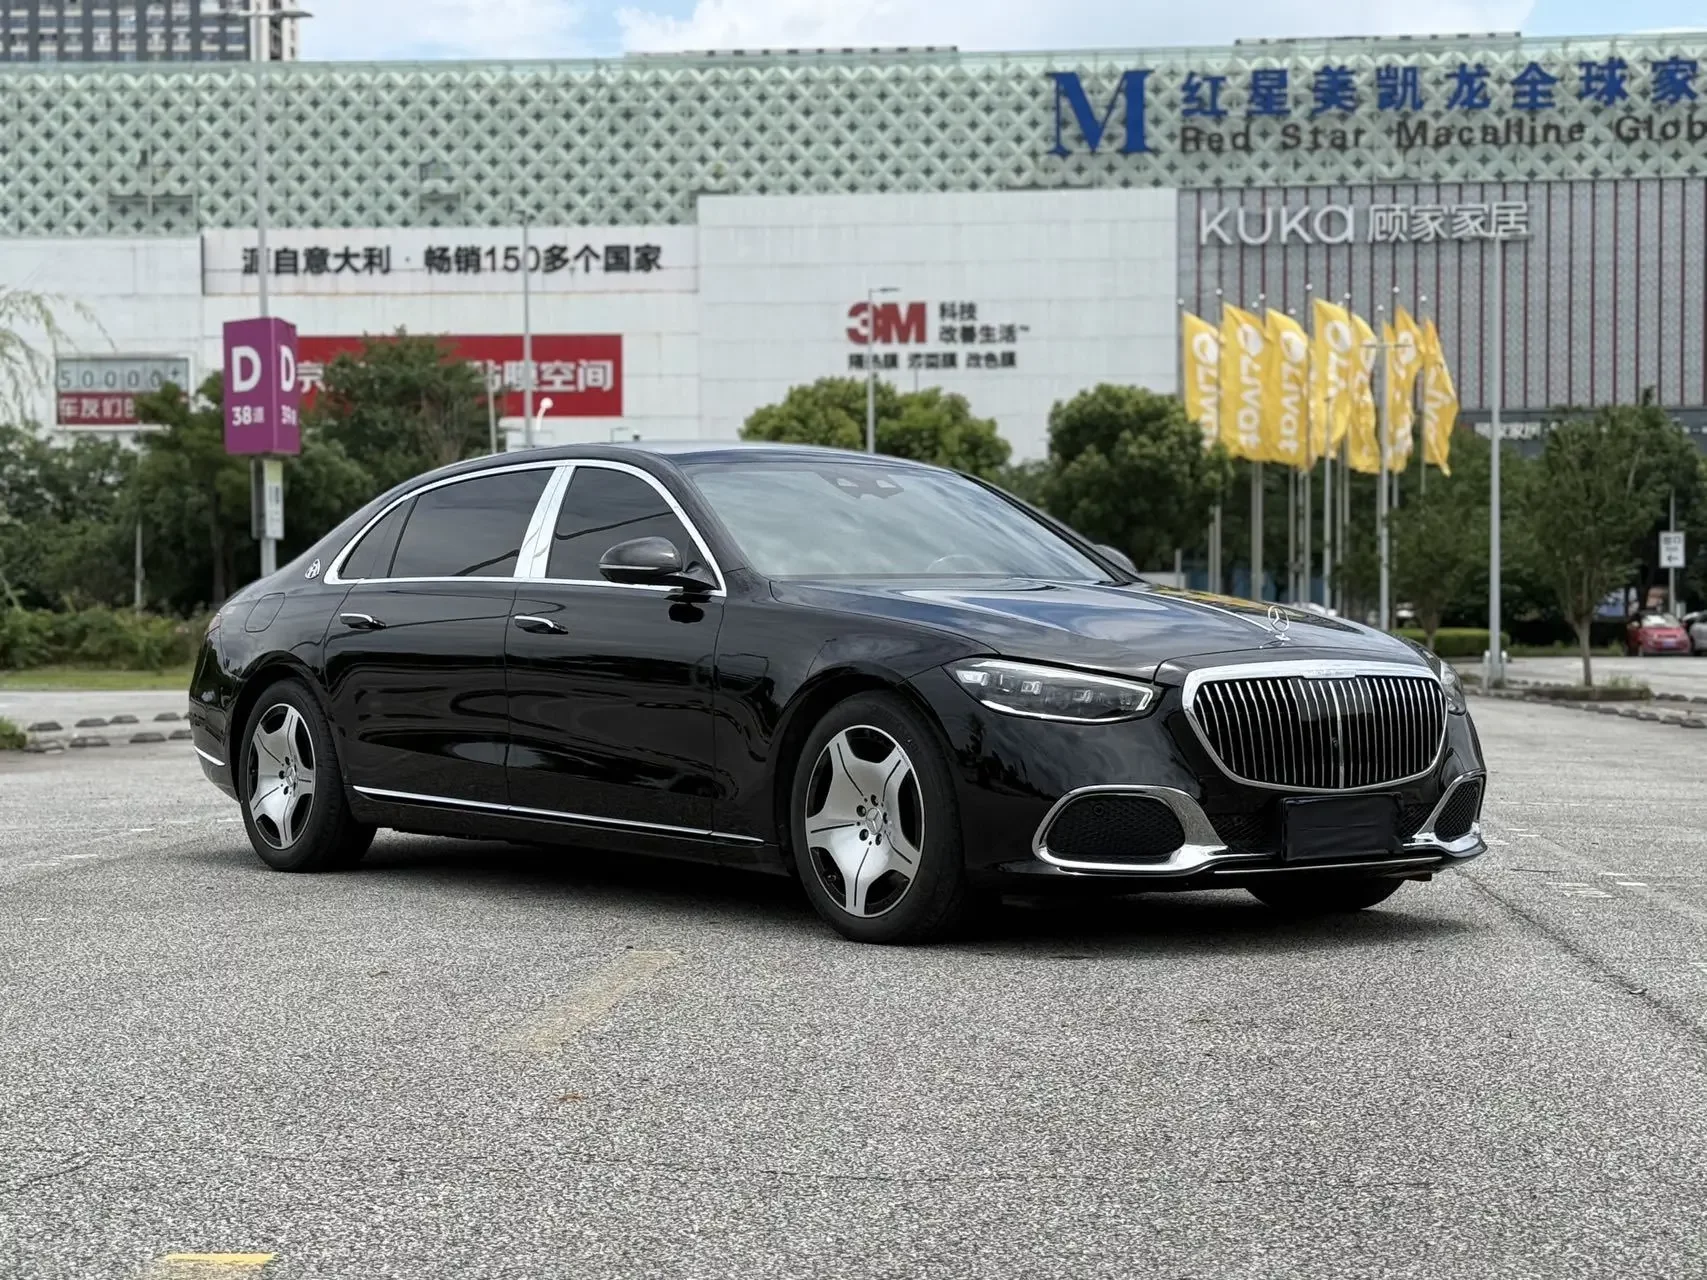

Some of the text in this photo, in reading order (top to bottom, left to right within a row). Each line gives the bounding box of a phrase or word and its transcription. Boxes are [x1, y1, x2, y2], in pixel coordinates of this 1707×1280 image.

[1180, 56, 1699, 118] 红星美凯龙全球家
[1041, 69, 1155, 158] M
[1180, 122, 1252, 153] Red
[1281, 119, 1368, 151] Star
[1367, 200, 1532, 244] 顾家家居
[846, 301, 927, 344] 3M
[231, 345, 262, 393] D
[279, 344, 296, 392] D
